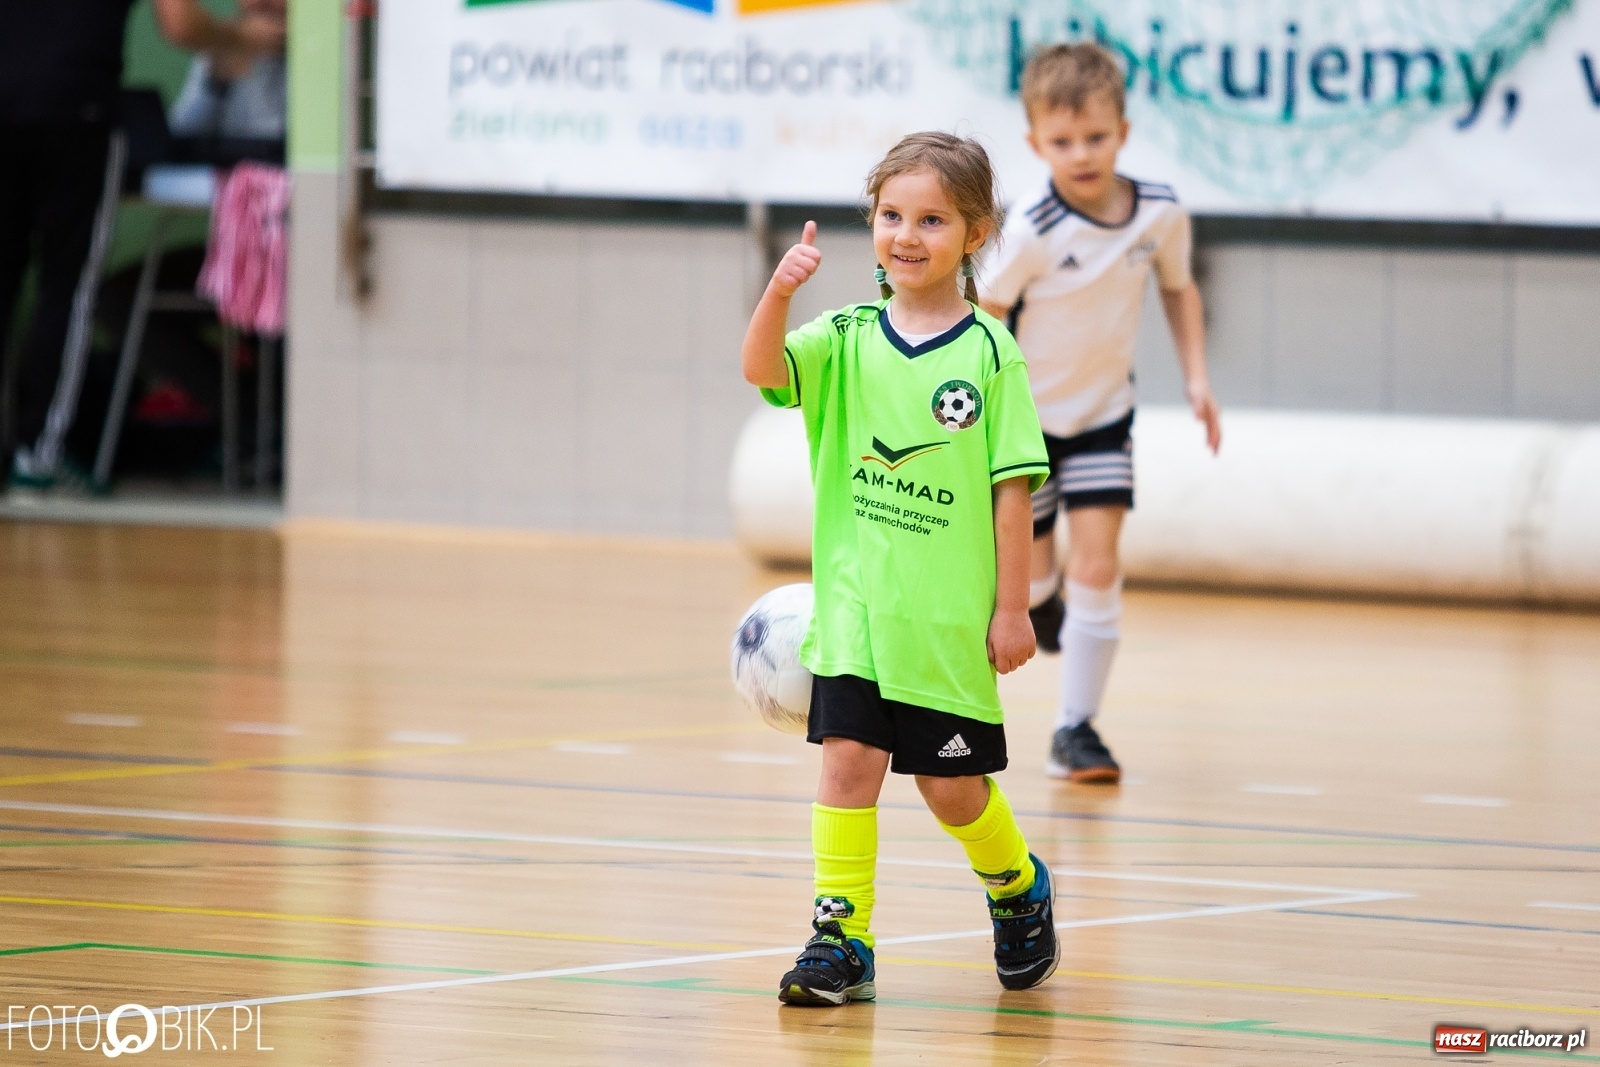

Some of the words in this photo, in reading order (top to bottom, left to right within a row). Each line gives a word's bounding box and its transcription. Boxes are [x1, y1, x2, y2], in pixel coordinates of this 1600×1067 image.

[449, 30, 629, 97] powiat
[1007, 16, 1520, 131] kbicujemy,
[850, 464, 954, 506] AM-MAD
[853, 494, 900, 515] ożyczalnia
[902, 509, 949, 528] przyczep
[855, 508, 866, 517] az
[868, 512, 931, 536] samochodów
[938, 747, 971, 758] adidas
[993, 907, 1013, 916] FILA
[821, 935, 842, 945] FILA
